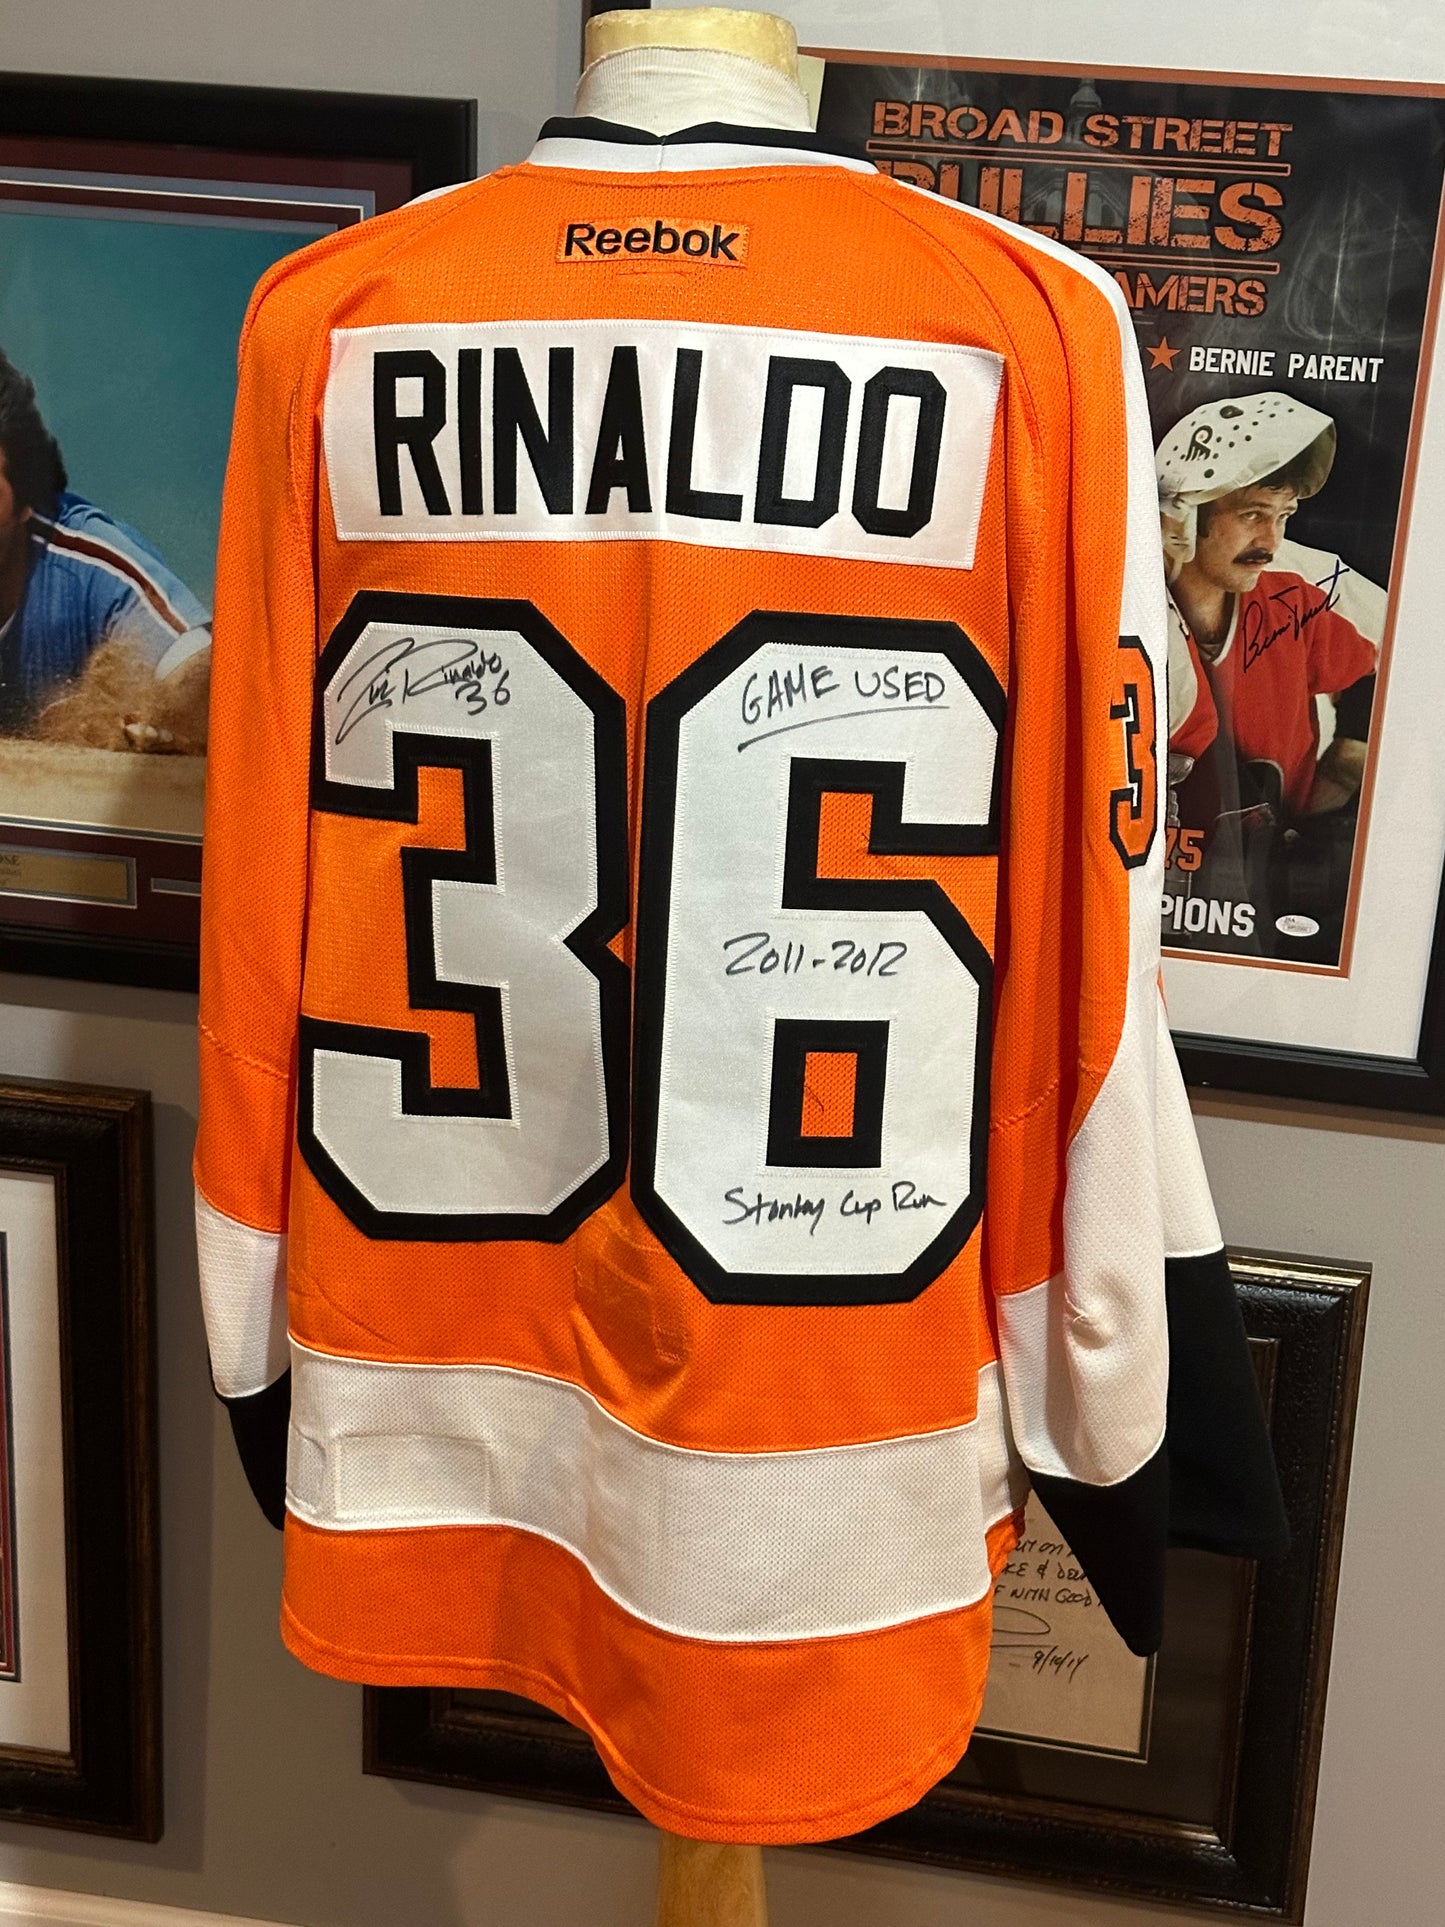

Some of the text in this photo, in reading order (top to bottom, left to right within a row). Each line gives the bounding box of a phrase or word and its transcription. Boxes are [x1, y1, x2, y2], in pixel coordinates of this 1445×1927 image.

[871, 100, 1293, 158] BROAD STREET
[564, 221, 740, 262] Reebok
[1189, 346, 1385, 383] BERNIE PARENT
[373, 345, 947, 538] RINALDO
[455, 669, 511, 717] 36
[741, 662, 946, 725] GAME USED
[298, 589, 1000, 1306] 36
[723, 931, 908, 977] 2011-2012
[839, 1189, 882, 1225] Cup
[891, 1180, 947, 1212] Run
